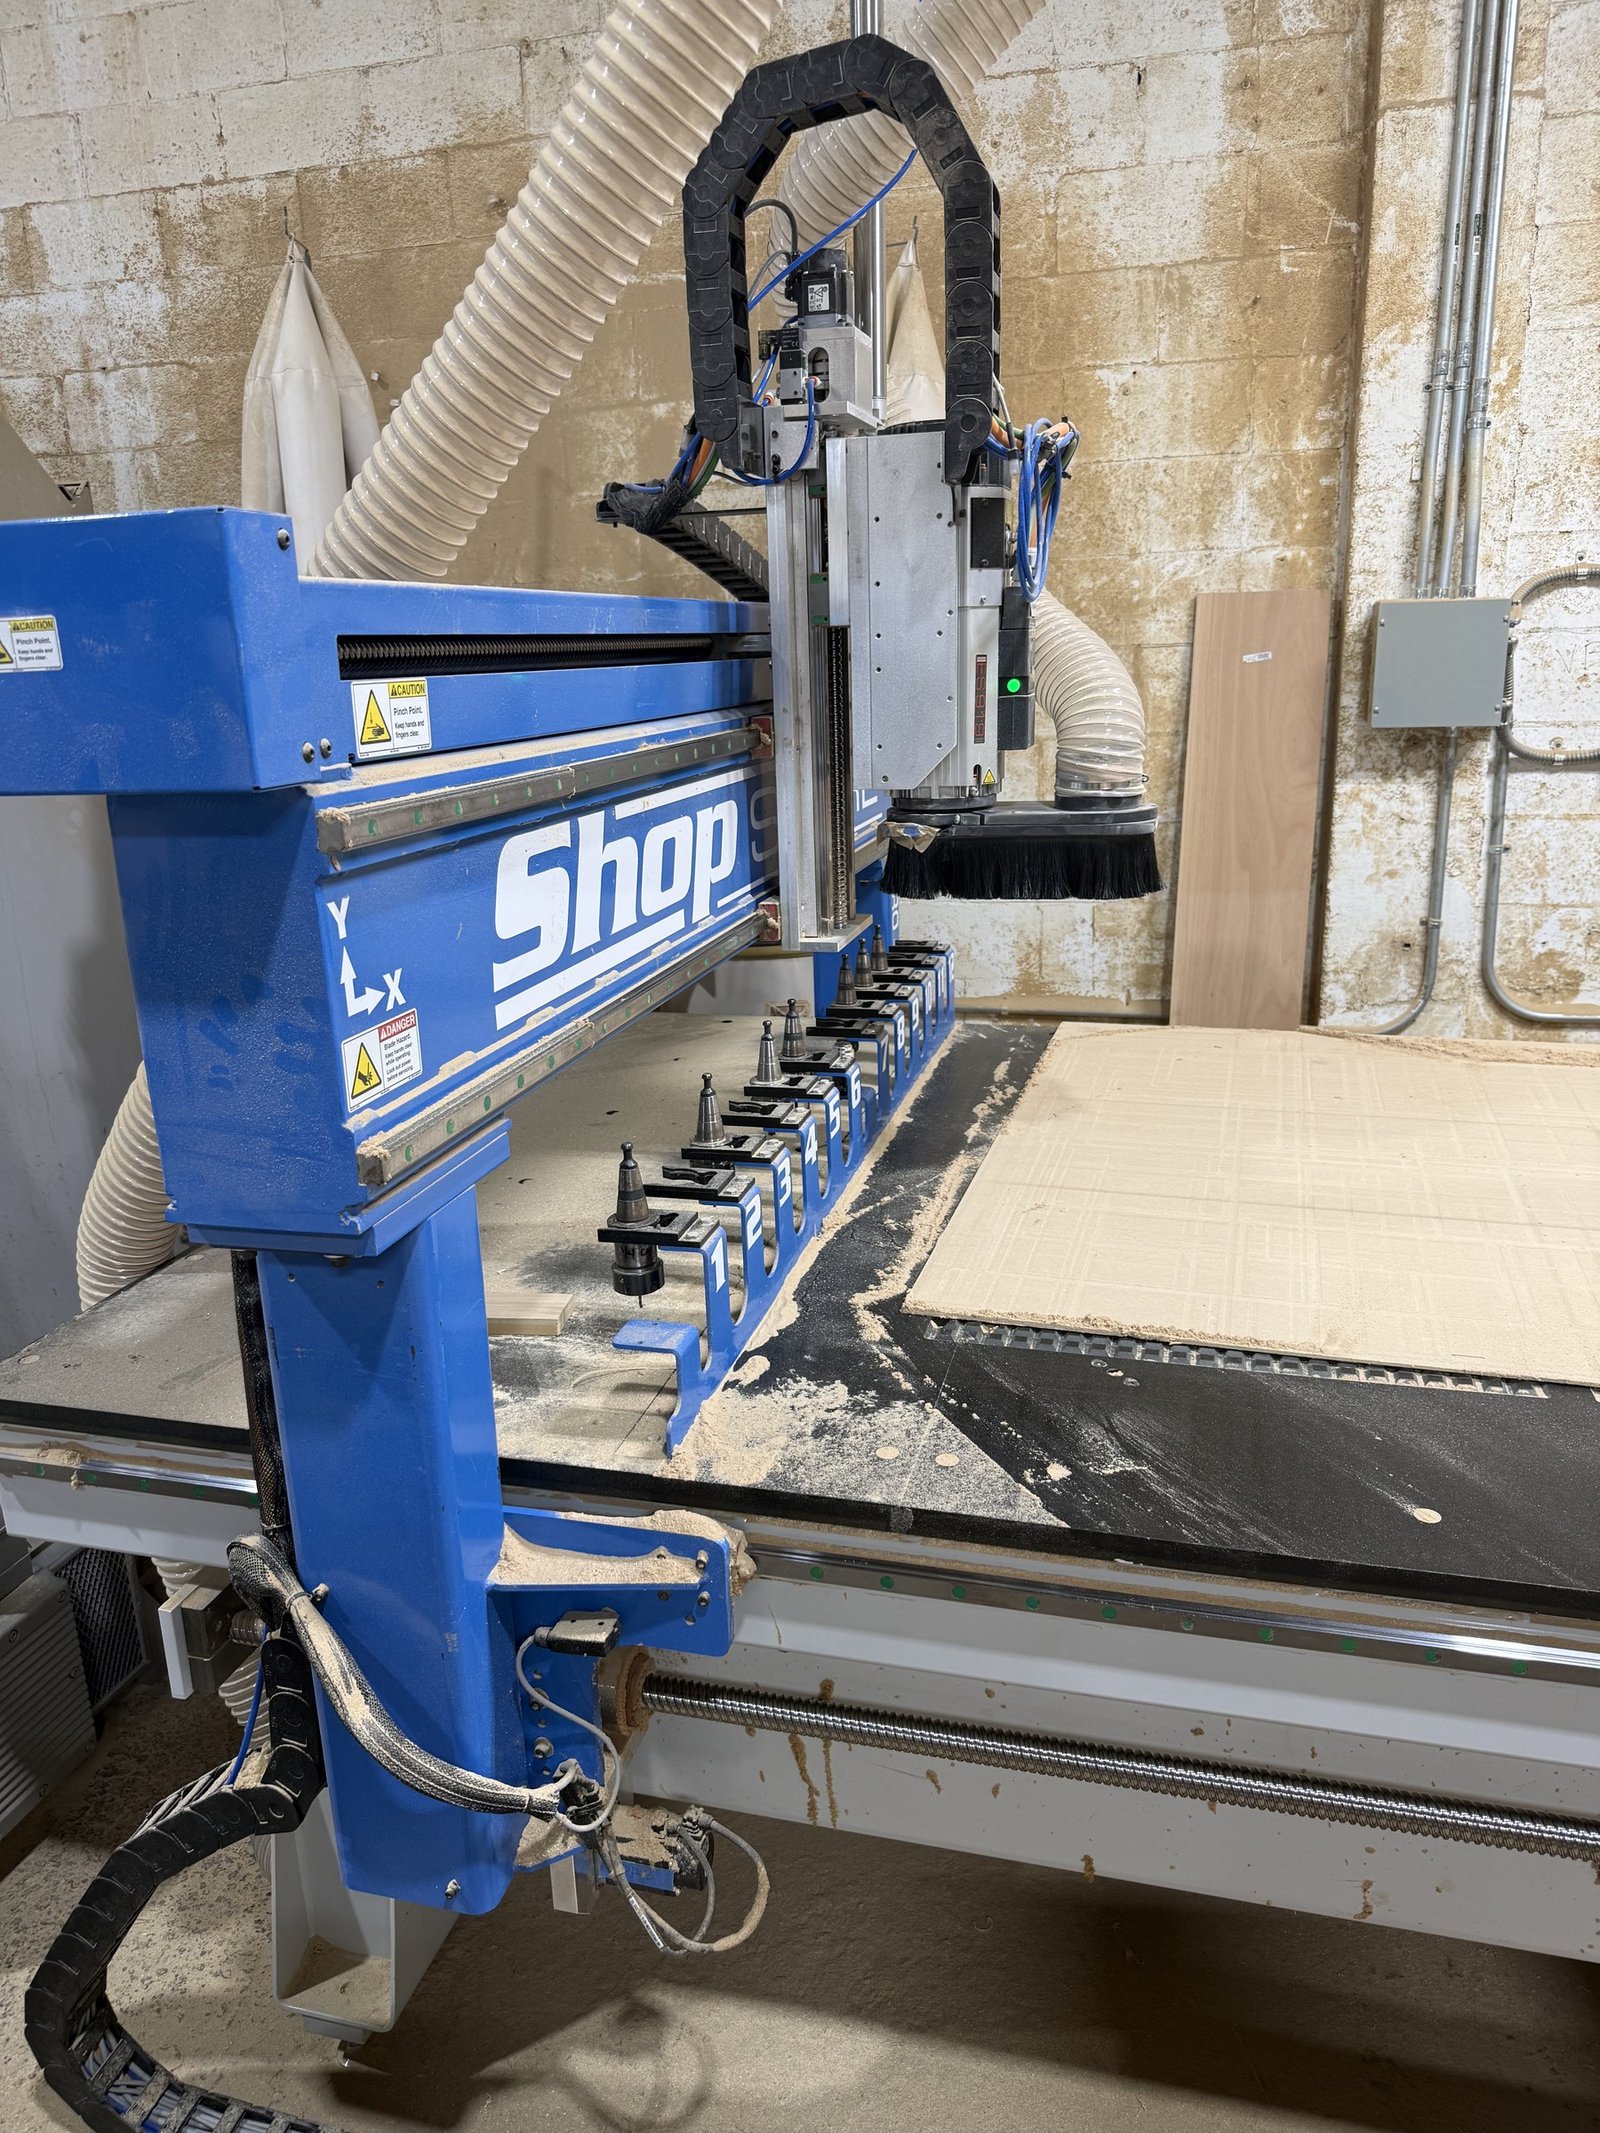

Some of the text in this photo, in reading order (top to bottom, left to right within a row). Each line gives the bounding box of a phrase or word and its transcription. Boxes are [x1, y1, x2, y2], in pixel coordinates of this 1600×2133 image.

[20, 620, 54, 631] CAUTION
[397, 683, 425, 696] CAUTION
[394, 706, 423, 716] Pinch Point.
[395, 722, 404, 730] Keep
[396, 731, 409, 740] fingers
[492, 800, 738, 993] Shop
[326, 896, 350, 940] Y
[382, 967, 406, 1011] X
[387, 1014, 415, 1036] DANGER
[912, 997, 919, 1031] 9
[384, 1040, 395, 1050] Blade
[897, 1014, 905, 1051] 8
[385, 1042, 413, 1059] Keep hands clear
[386, 1057, 395, 1066] while
[386, 1066, 395, 1075] Lock
[401, 1059, 411, 1069] power
[881, 1034, 889, 1073] 7
[387, 1073, 398, 1082] before
[851, 1067, 861, 1109] 6
[829, 1093, 840, 1140] 5
[805, 1122, 818, 1165] 4
[778, 1156, 791, 1208] 3
[745, 1194, 762, 1251] 2
[711, 1237, 726, 1293] 1
